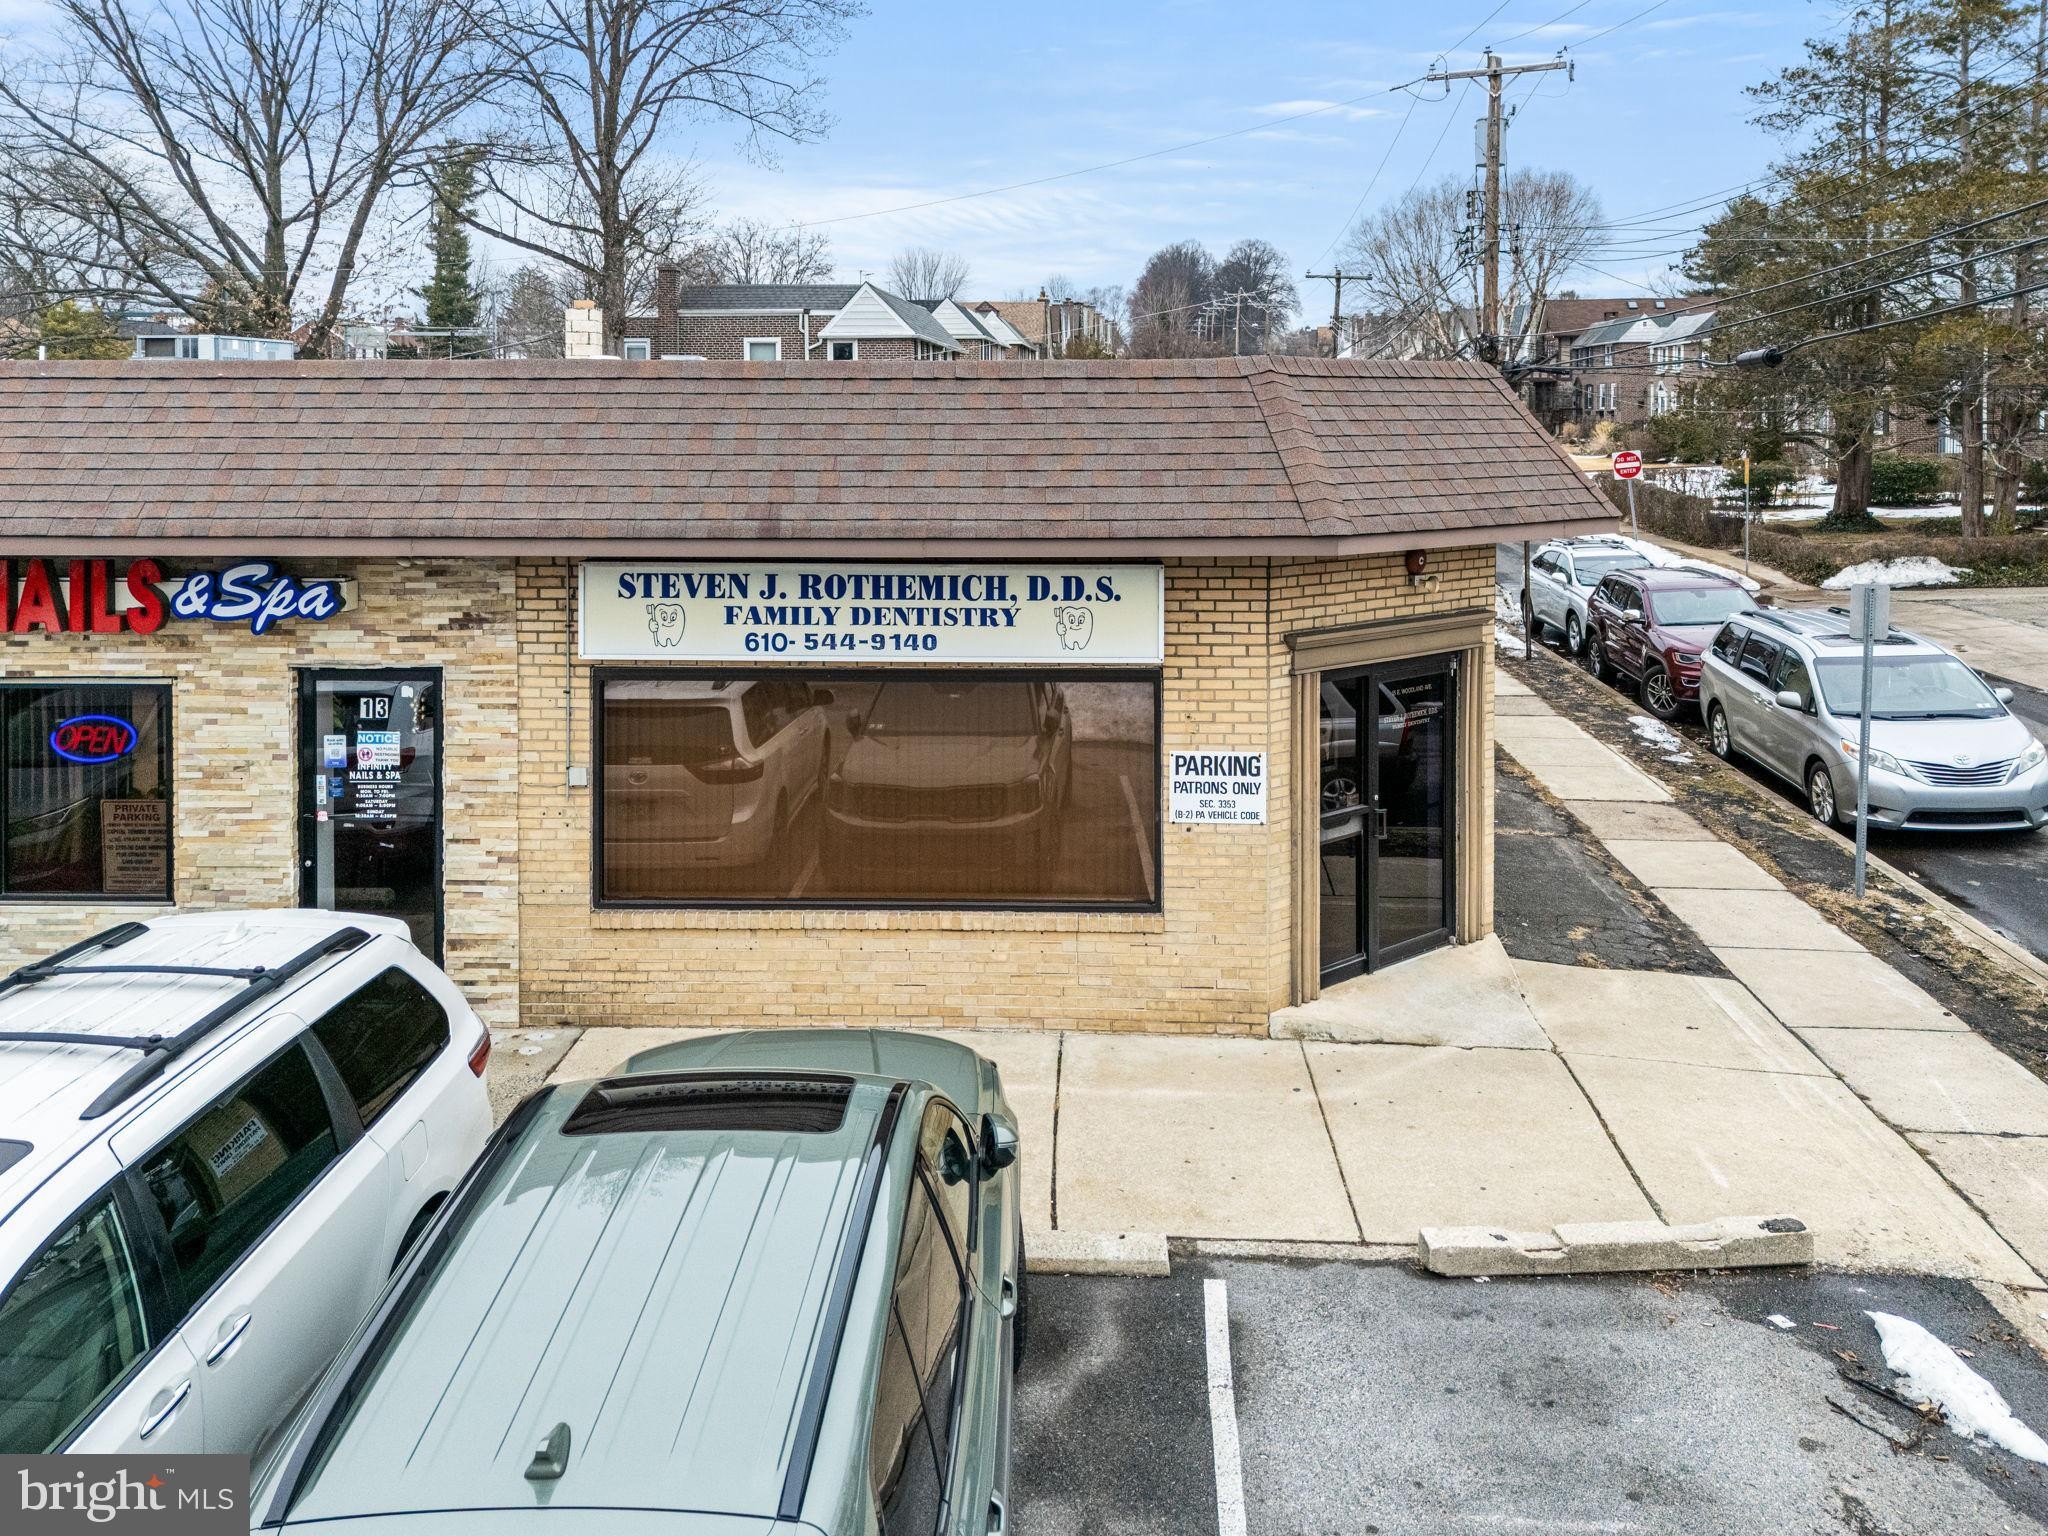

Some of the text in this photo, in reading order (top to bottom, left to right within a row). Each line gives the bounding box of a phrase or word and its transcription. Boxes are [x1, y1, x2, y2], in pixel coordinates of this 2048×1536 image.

[617, 572, 1123, 607] STEVEN J. ROTHEMICH, D.D.S.
[723, 605, 1022, 628] FAMILY DENTISTRY
[363, 698, 387, 718] 13
[56, 725, 129, 754] OPEN
[358, 734, 400, 743] NOTICE
[1174, 755, 1261, 777] PARKING
[349, 771, 401, 780] NAILS & SPA
[1174, 781, 1262, 795] PATRONS ONLY
[114, 804, 158, 812] PRIVATE
[1200, 800, 1236, 808] SEC. 3353
[1196, 811, 1205, 819] PA
[1208, 812, 1238, 820] VEHICLE
[1240, 812, 1260, 820] CODE
